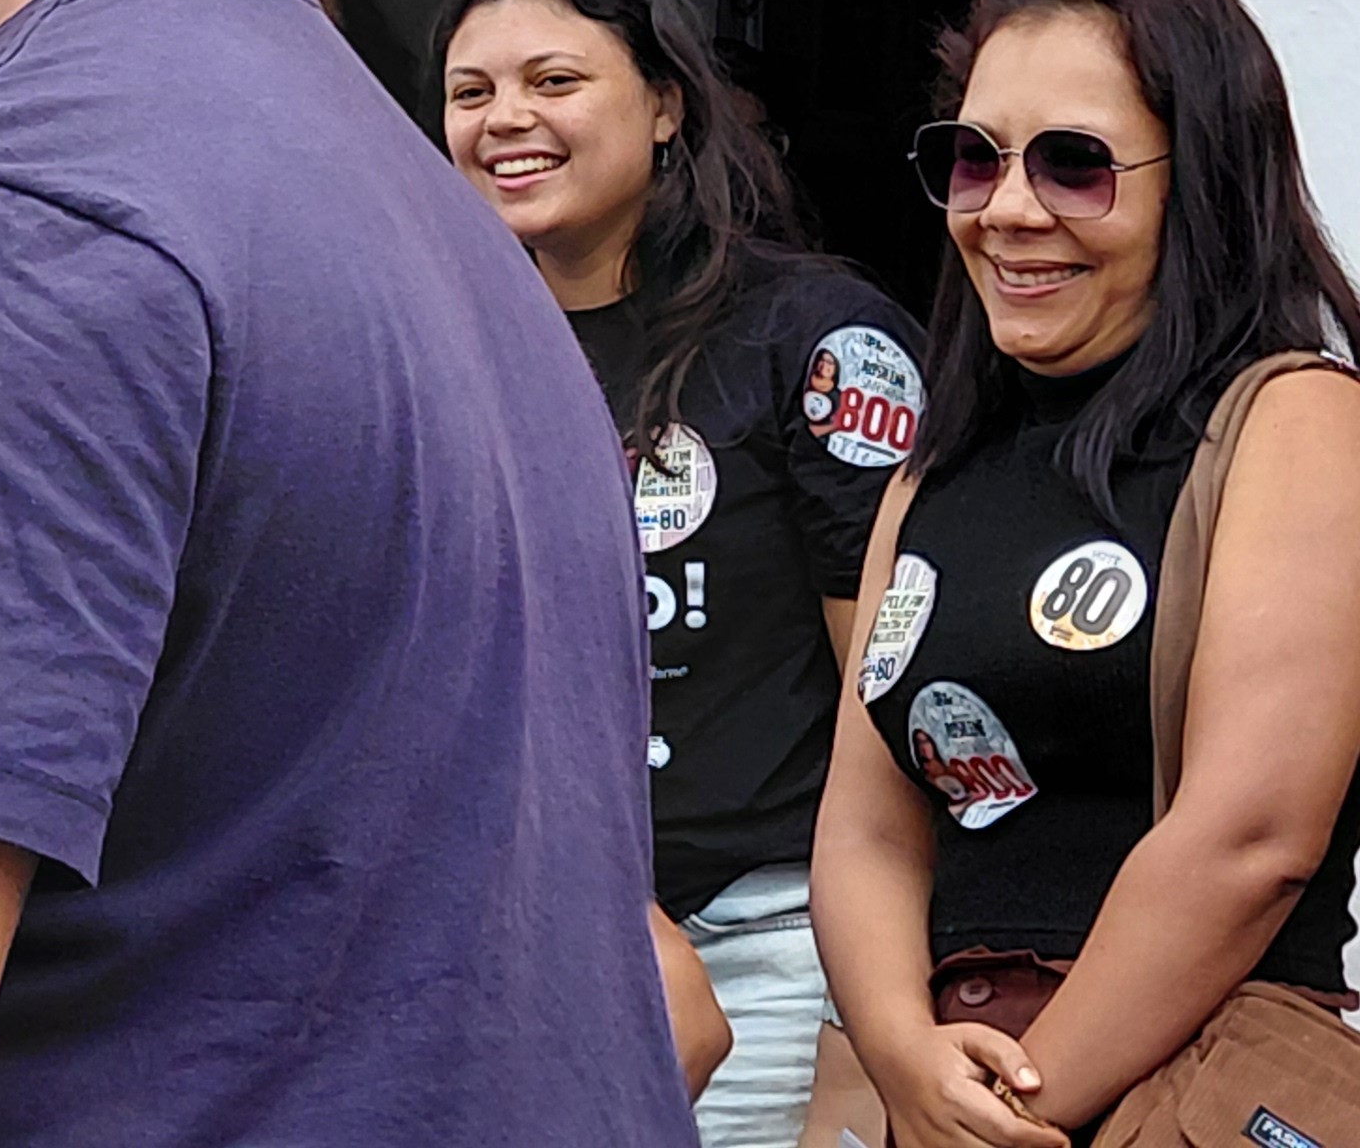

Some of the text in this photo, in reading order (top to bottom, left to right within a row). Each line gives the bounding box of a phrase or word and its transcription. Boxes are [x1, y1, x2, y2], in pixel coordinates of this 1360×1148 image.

[837, 386, 916, 452] 800
[660, 508, 686, 531] 80
[1042, 557, 1132, 635] 80
